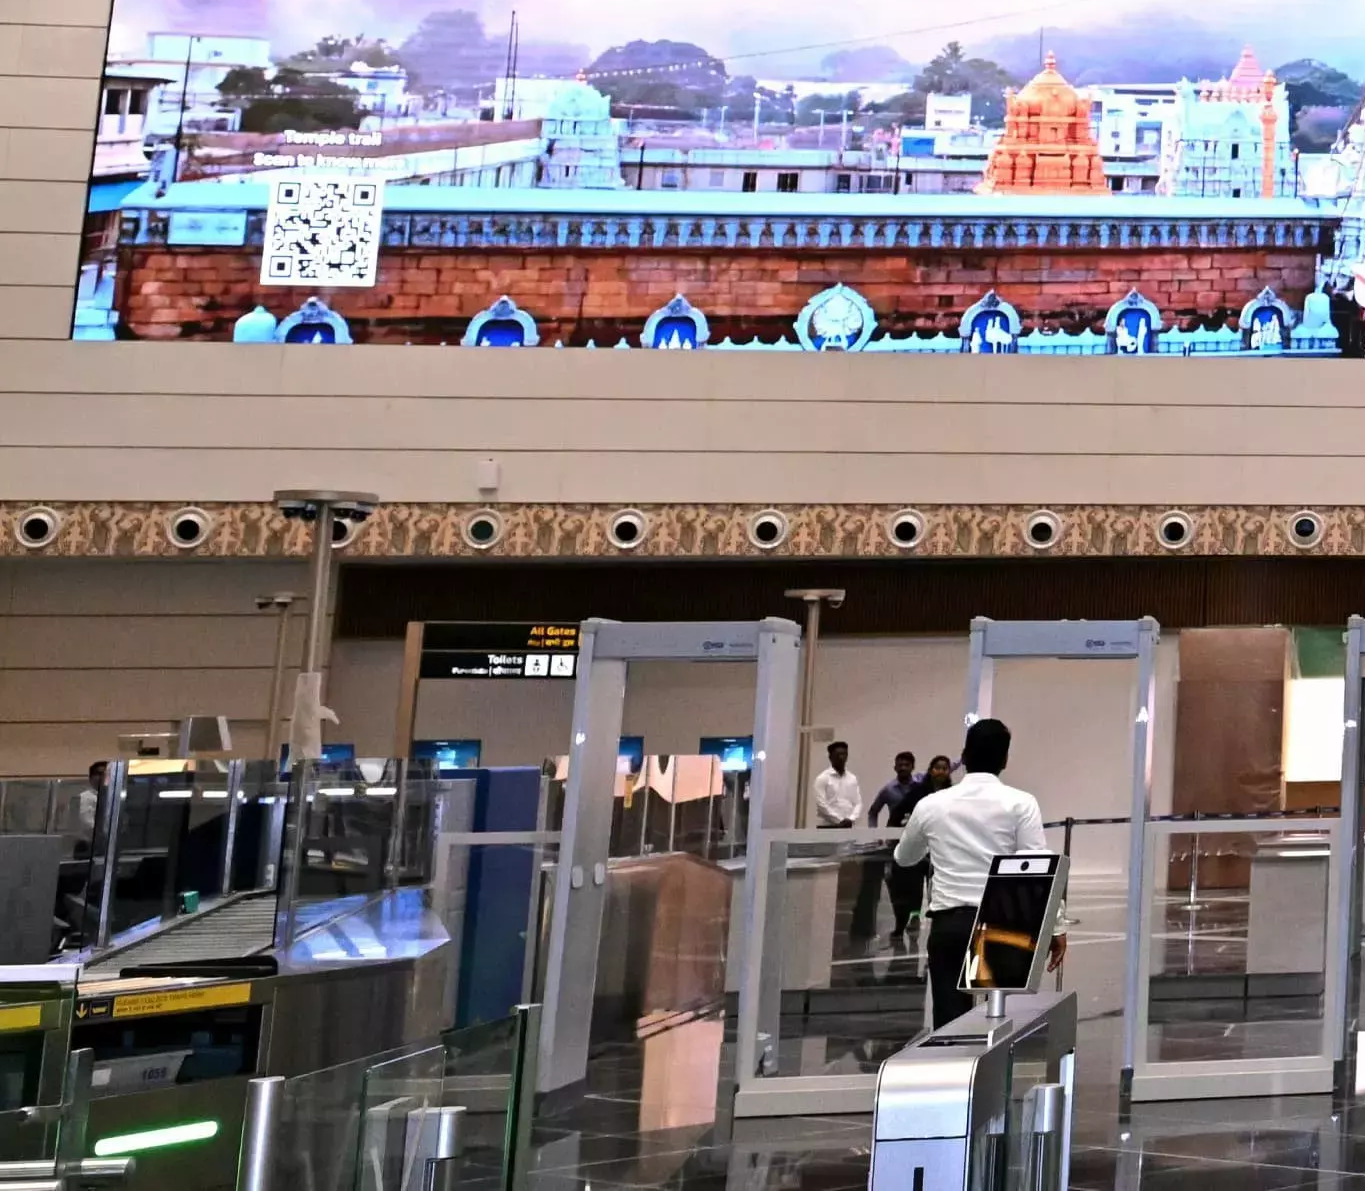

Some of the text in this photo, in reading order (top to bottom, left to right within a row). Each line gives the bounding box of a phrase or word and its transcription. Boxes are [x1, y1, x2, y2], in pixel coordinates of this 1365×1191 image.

[284, 129, 382, 147] Temple trail
[253, 152, 295, 166] Scan
[297, 154, 315, 166] to
[530, 626, 576, 636] All Gates
[488, 654, 523, 664] Toilets
